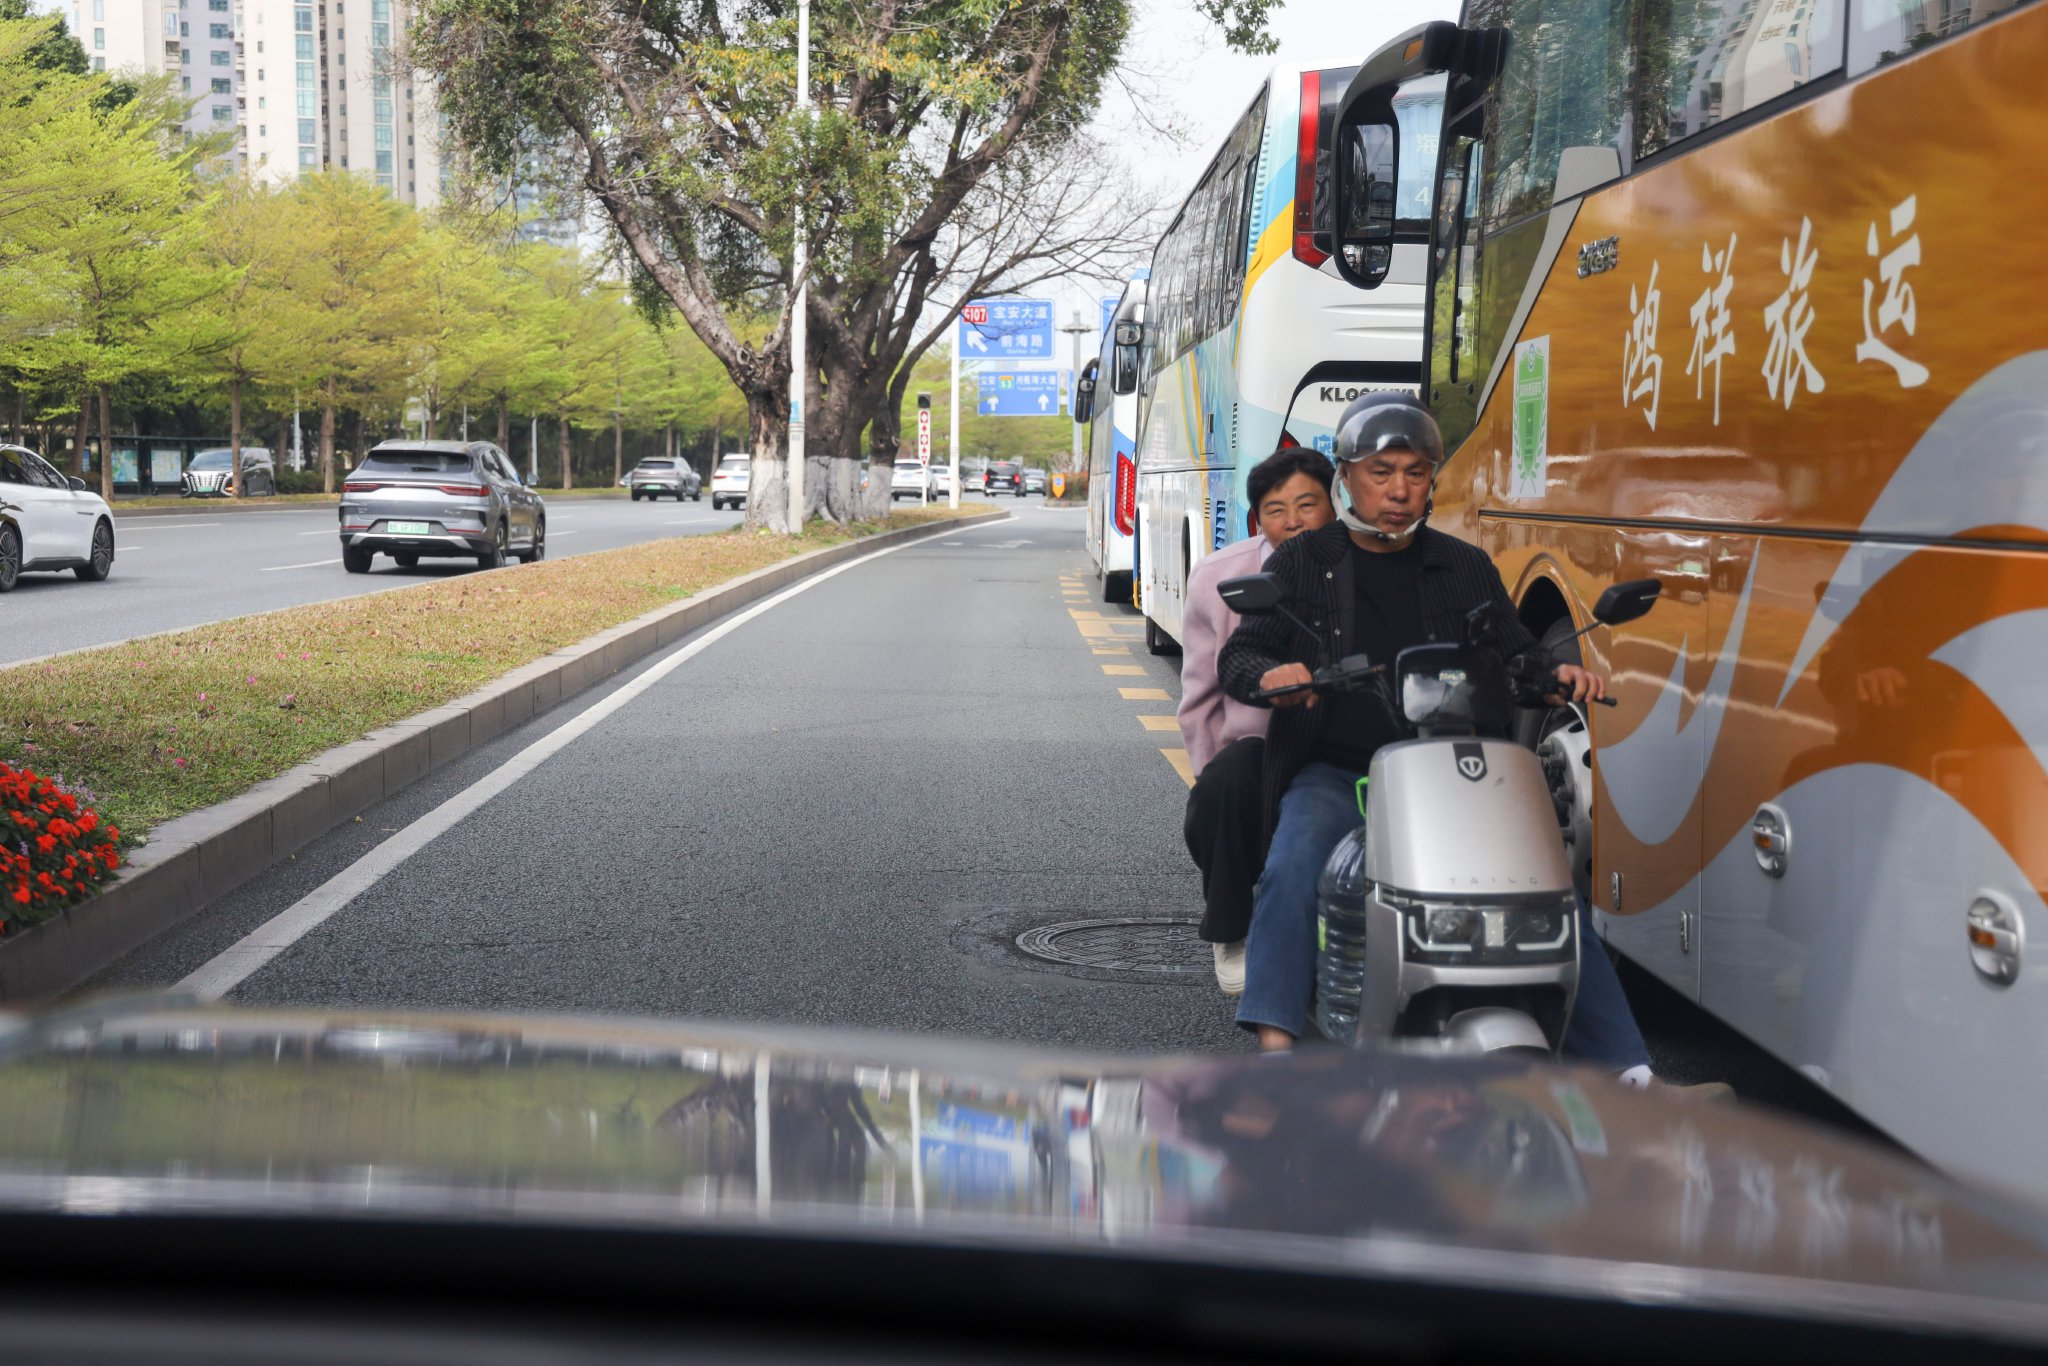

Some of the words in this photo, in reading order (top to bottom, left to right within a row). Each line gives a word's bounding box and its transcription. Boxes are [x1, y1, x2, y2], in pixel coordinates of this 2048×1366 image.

[1414, 186, 1431, 206] 4
[964, 308, 987, 321] G107
[993, 306, 1048, 319] 宝安大道
[1623, 193, 1930, 432] 鸿祥旅运
